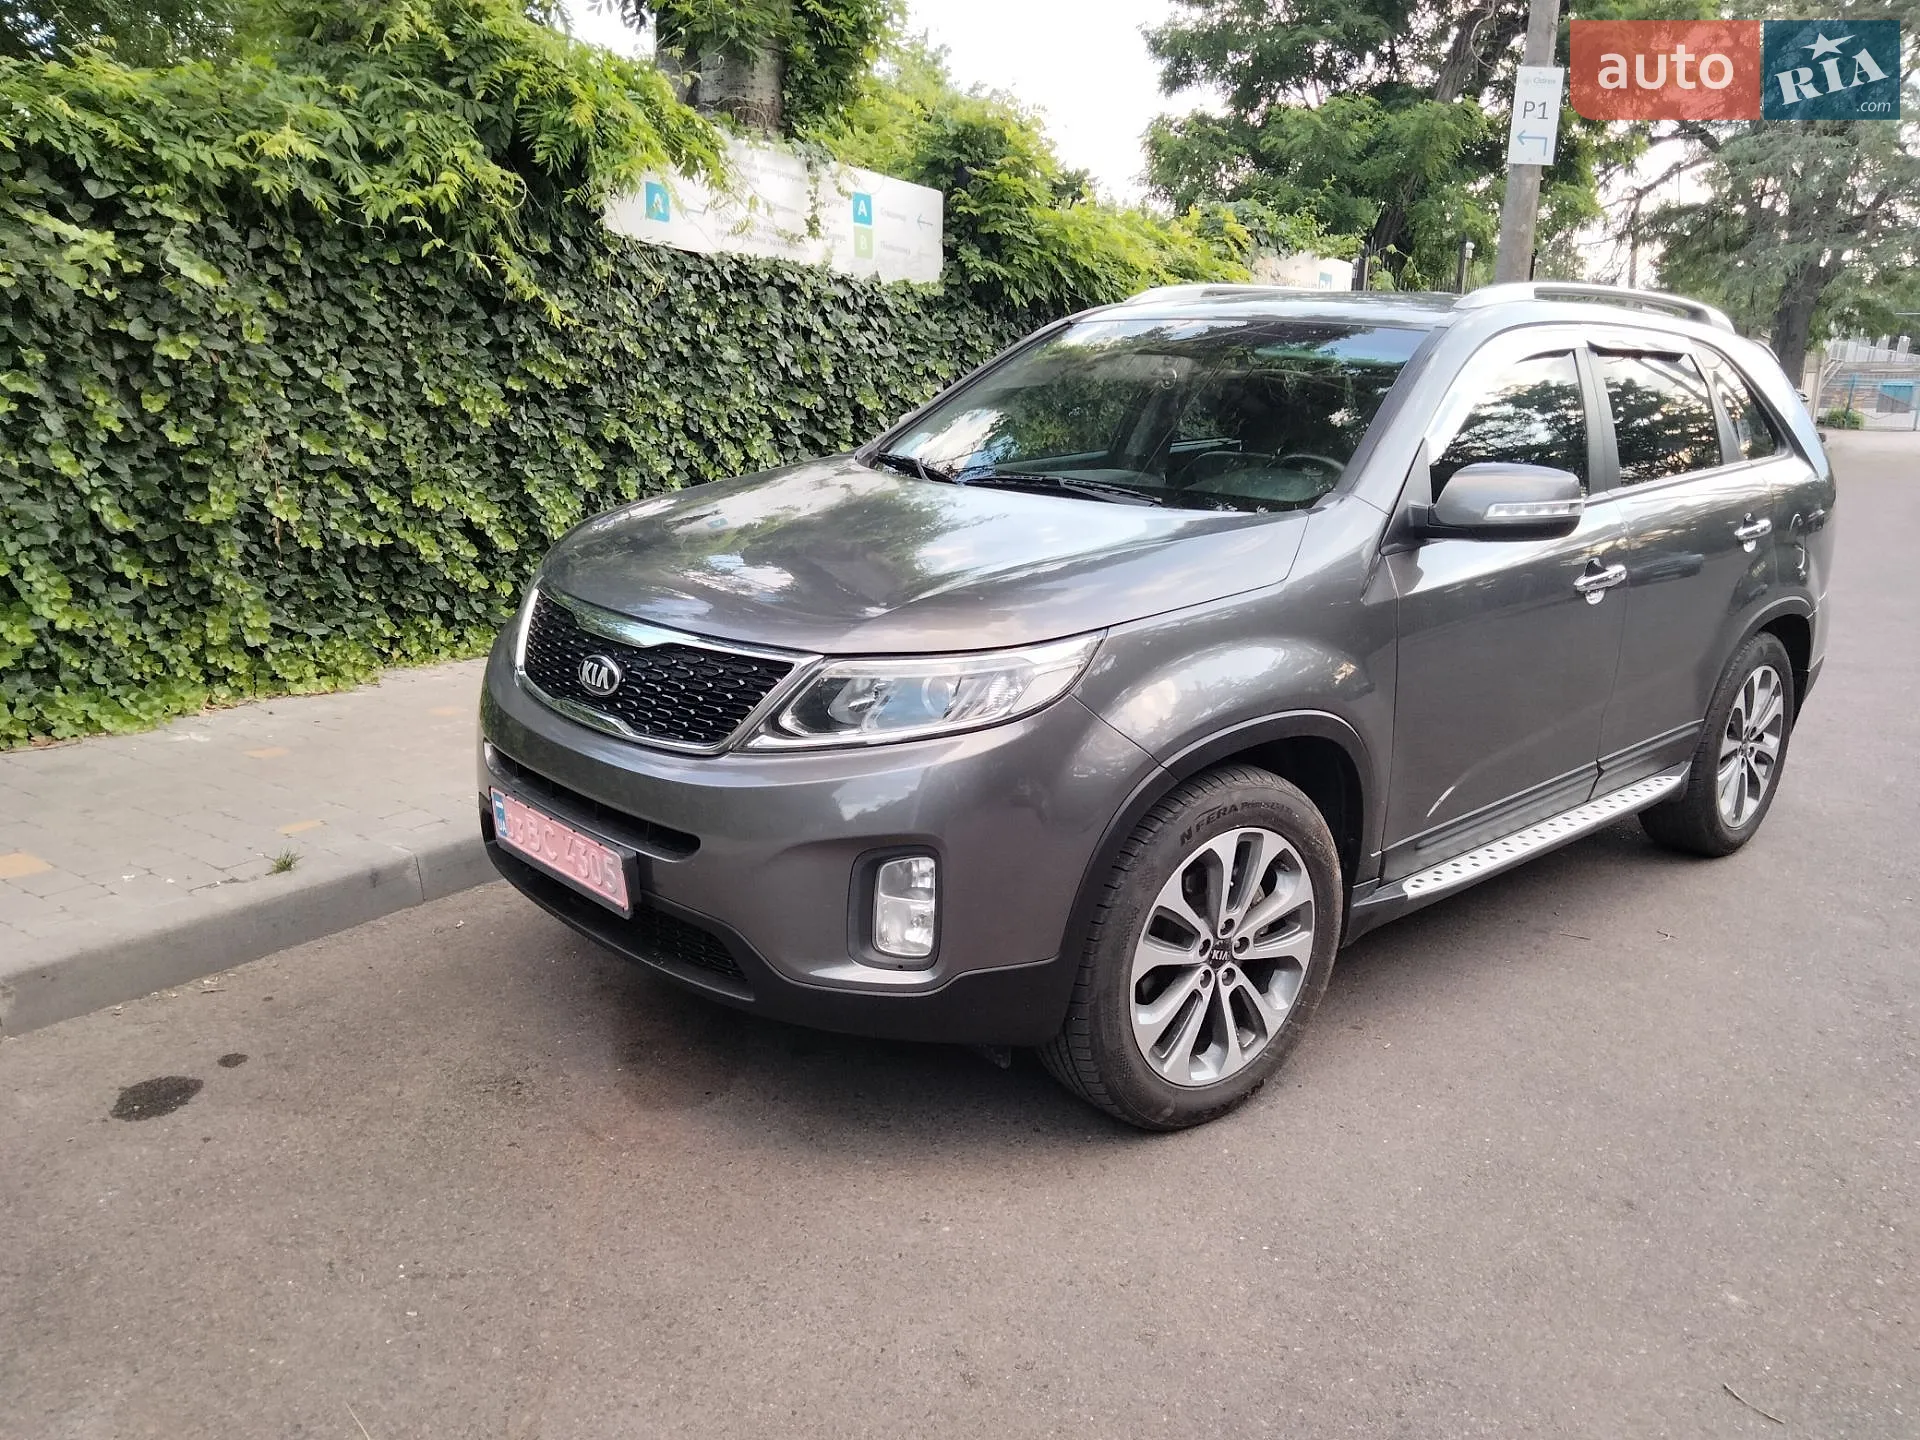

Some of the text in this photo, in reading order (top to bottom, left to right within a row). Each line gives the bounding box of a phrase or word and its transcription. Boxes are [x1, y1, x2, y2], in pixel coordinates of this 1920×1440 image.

[1522, 100, 1549, 120] P1
[857, 199, 868, 217] A
[581, 660, 609, 690] KIA
[1195, 804, 1238, 832] FERA
[1211, 949, 1228, 961] KIA
